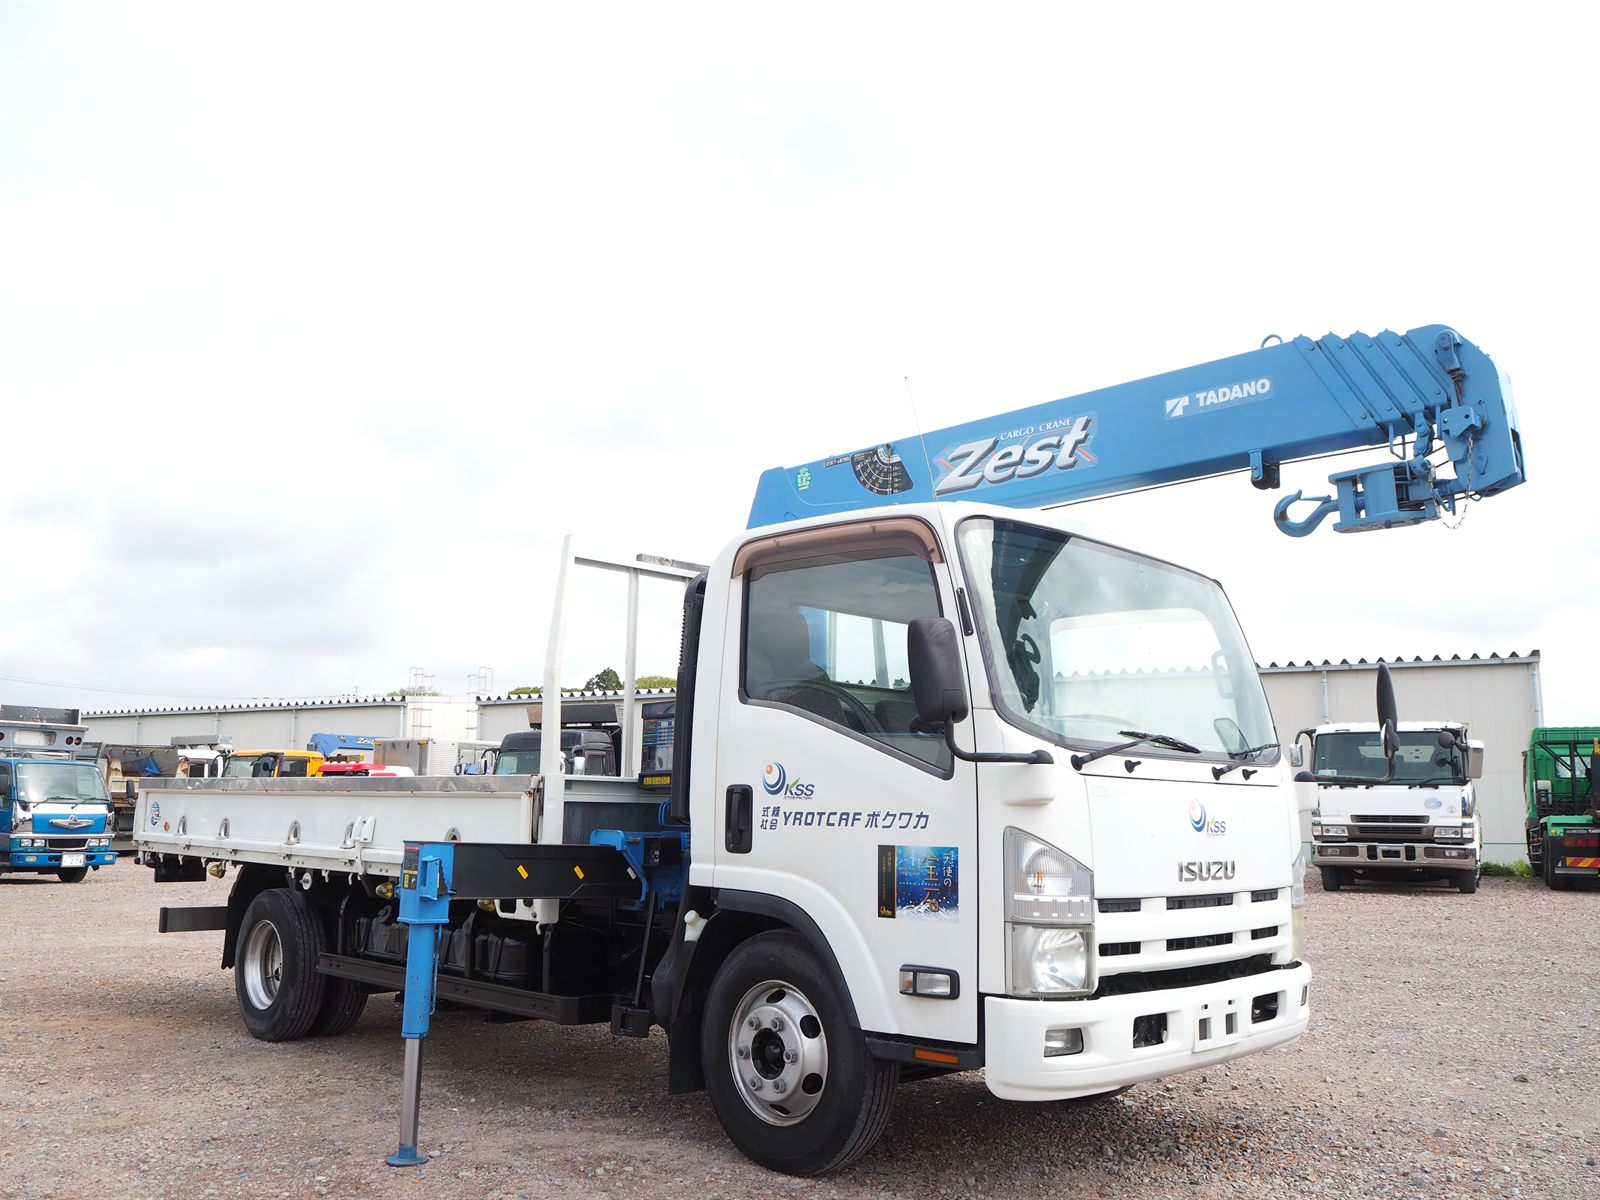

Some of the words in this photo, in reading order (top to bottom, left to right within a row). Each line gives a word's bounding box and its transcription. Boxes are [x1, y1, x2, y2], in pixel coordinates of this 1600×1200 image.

[1196, 378, 1270, 407] TADANO
[1000, 426, 1034, 441] CARGO
[1039, 417, 1073, 432] CRANE
[935, 415, 1092, 496] Zest
[784, 777, 815, 797] KSS
[783, 811, 862, 827] YROTCAF
[1206, 816, 1227, 833] KSS
[1178, 860, 1236, 882] ISUZU
